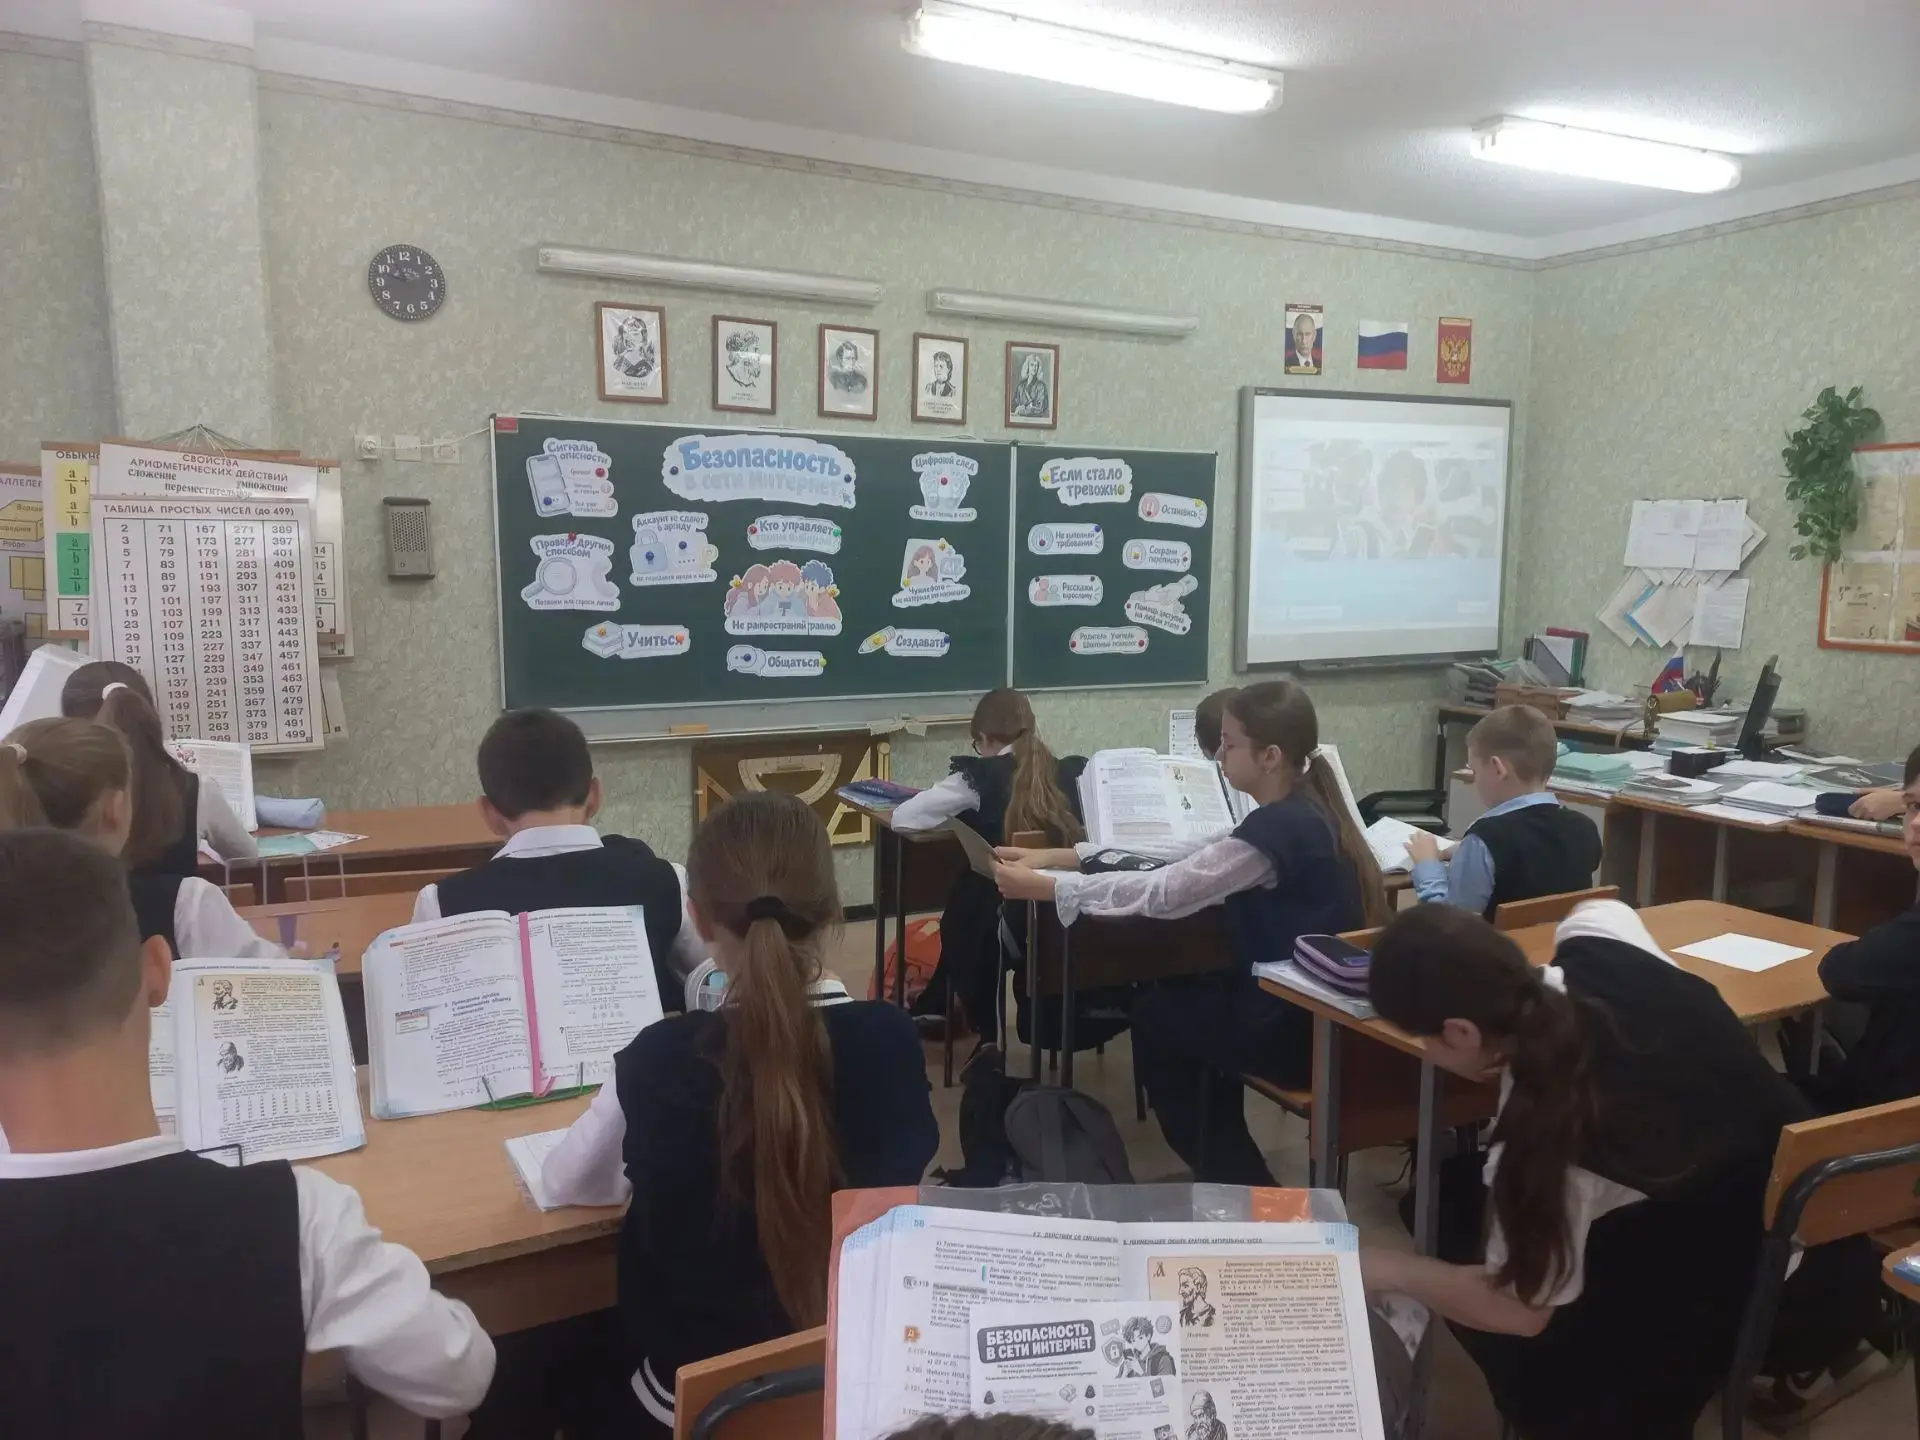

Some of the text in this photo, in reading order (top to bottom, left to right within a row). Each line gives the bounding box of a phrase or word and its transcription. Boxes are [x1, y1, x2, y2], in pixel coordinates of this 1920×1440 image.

[399, 252, 410, 262] 12
[416, 256, 422, 264] 1
[378, 264, 390, 274] 10
[424, 266, 432, 274] 2
[376, 278, 384, 286] 9
[430, 279, 438, 288] 3
[382, 290, 390, 300] 8
[428, 291, 434, 300] 4
[393, 301, 400, 310] 7
[406, 304, 415, 313] 6
[420, 301, 428, 310] 5
[182, 454, 240, 468] СВОЙСТВА
[678, 441, 842, 476] Безопасность
[130, 458, 288, 482] АРИФМЕТИЧЕСКИХ ДЕЙСТВИЙ
[956, 458, 974, 472] след
[128, 468, 288, 492] сложение умножение
[1050, 466, 1122, 484] Если стало
[1067, 484, 1118, 498] тревожн
[104, 504, 295, 516] ТАБЛИЦА ПРОСТЫХ ЧИСЕЛ (до 499)
[120, 524, 292, 534] 2 71 167 271 389
[760, 520, 834, 536] Кто управляет
[122, 536, 292, 546] 3 73 173 277 397
[122, 548, 292, 558] 5 79 179 281 401
[546, 548, 591, 558] способом
[124, 560, 294, 568] 7 83 181 283 409
[315, 561, 326, 570] 15
[122, 572, 296, 582] 11 89 191 293 419
[317, 573, 324, 582] 4
[124, 582, 296, 594] 13 97 193 307 421
[316, 588, 327, 597] 15
[124, 594, 296, 606] 17 101 197 311 431
[76, 603, 83, 612] 7
[126, 606, 298, 618] 19 103 199 313 433
[73, 618, 88, 626] 10
[124, 616, 298, 628] 23 107 211 317 439
[732, 620, 744, 630] Не
[126, 628, 298, 642] 29 109 223 331 443
[896, 634, 946, 648] Создавать
[126, 640, 300, 654] 31 113 227 337 449
[127, 650, 300, 664] 37 127 229 347 457
[768, 656, 820, 669] Общаться
[986, 1323, 1089, 1346] БЕЗОПАСНОСТЬ
[986, 1336, 1092, 1360] В СЕТИ ИНТЕРНЕТ
